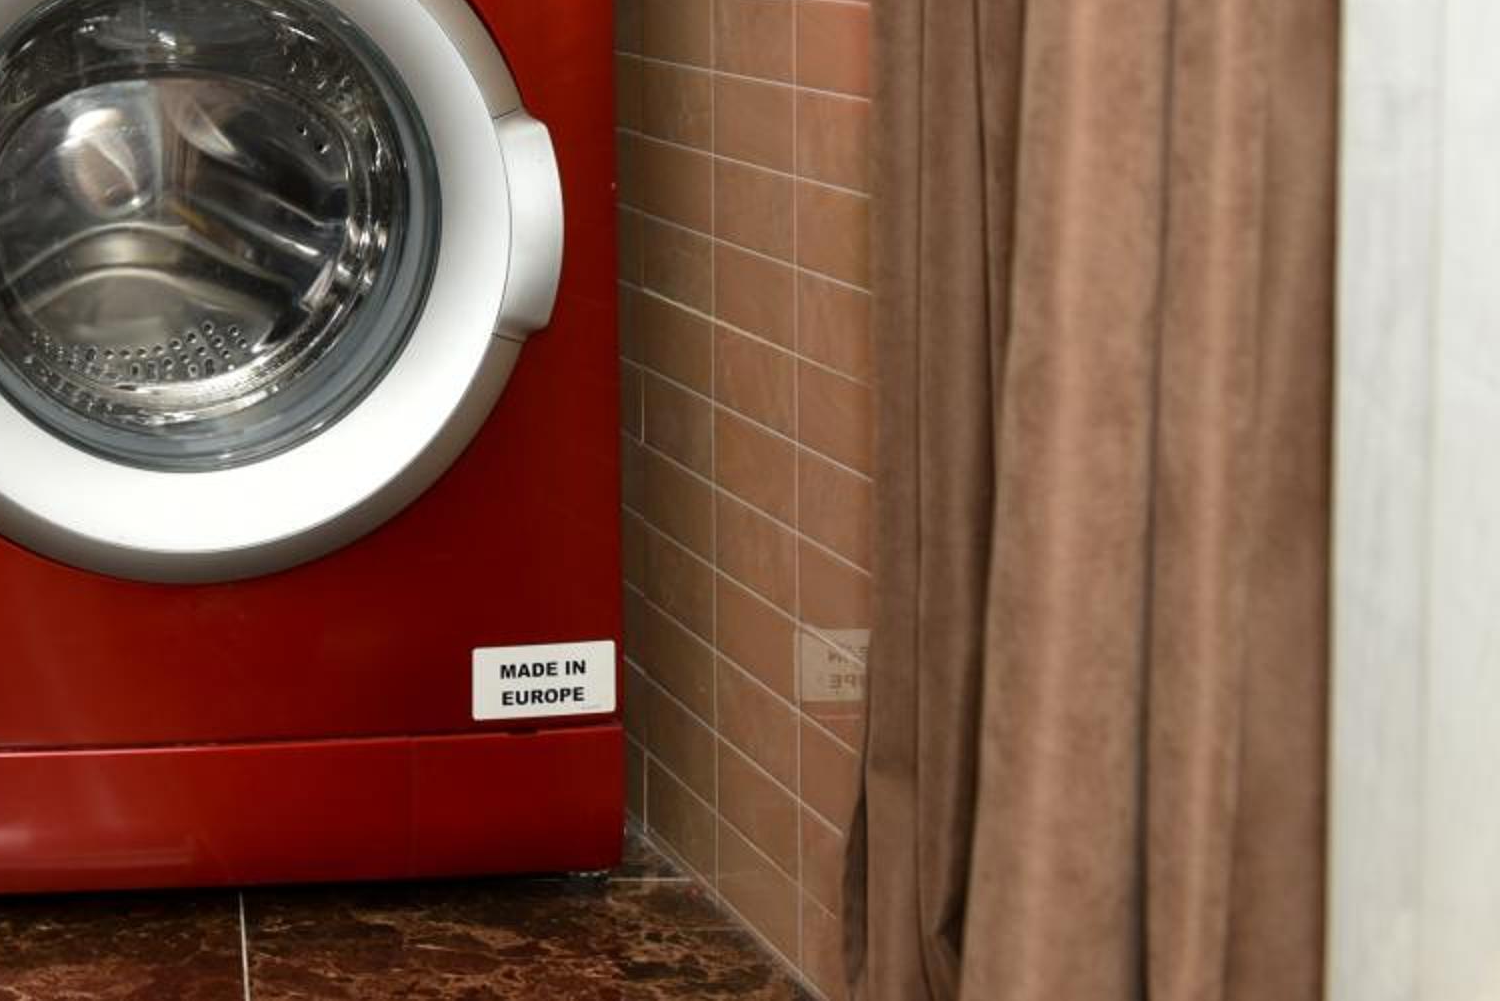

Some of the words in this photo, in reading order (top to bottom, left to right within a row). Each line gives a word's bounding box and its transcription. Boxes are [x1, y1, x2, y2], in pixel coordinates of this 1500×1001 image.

[499, 661, 558, 680] MADE
[564, 659, 586, 676] IN
[501, 686, 585, 707] EUROPE
